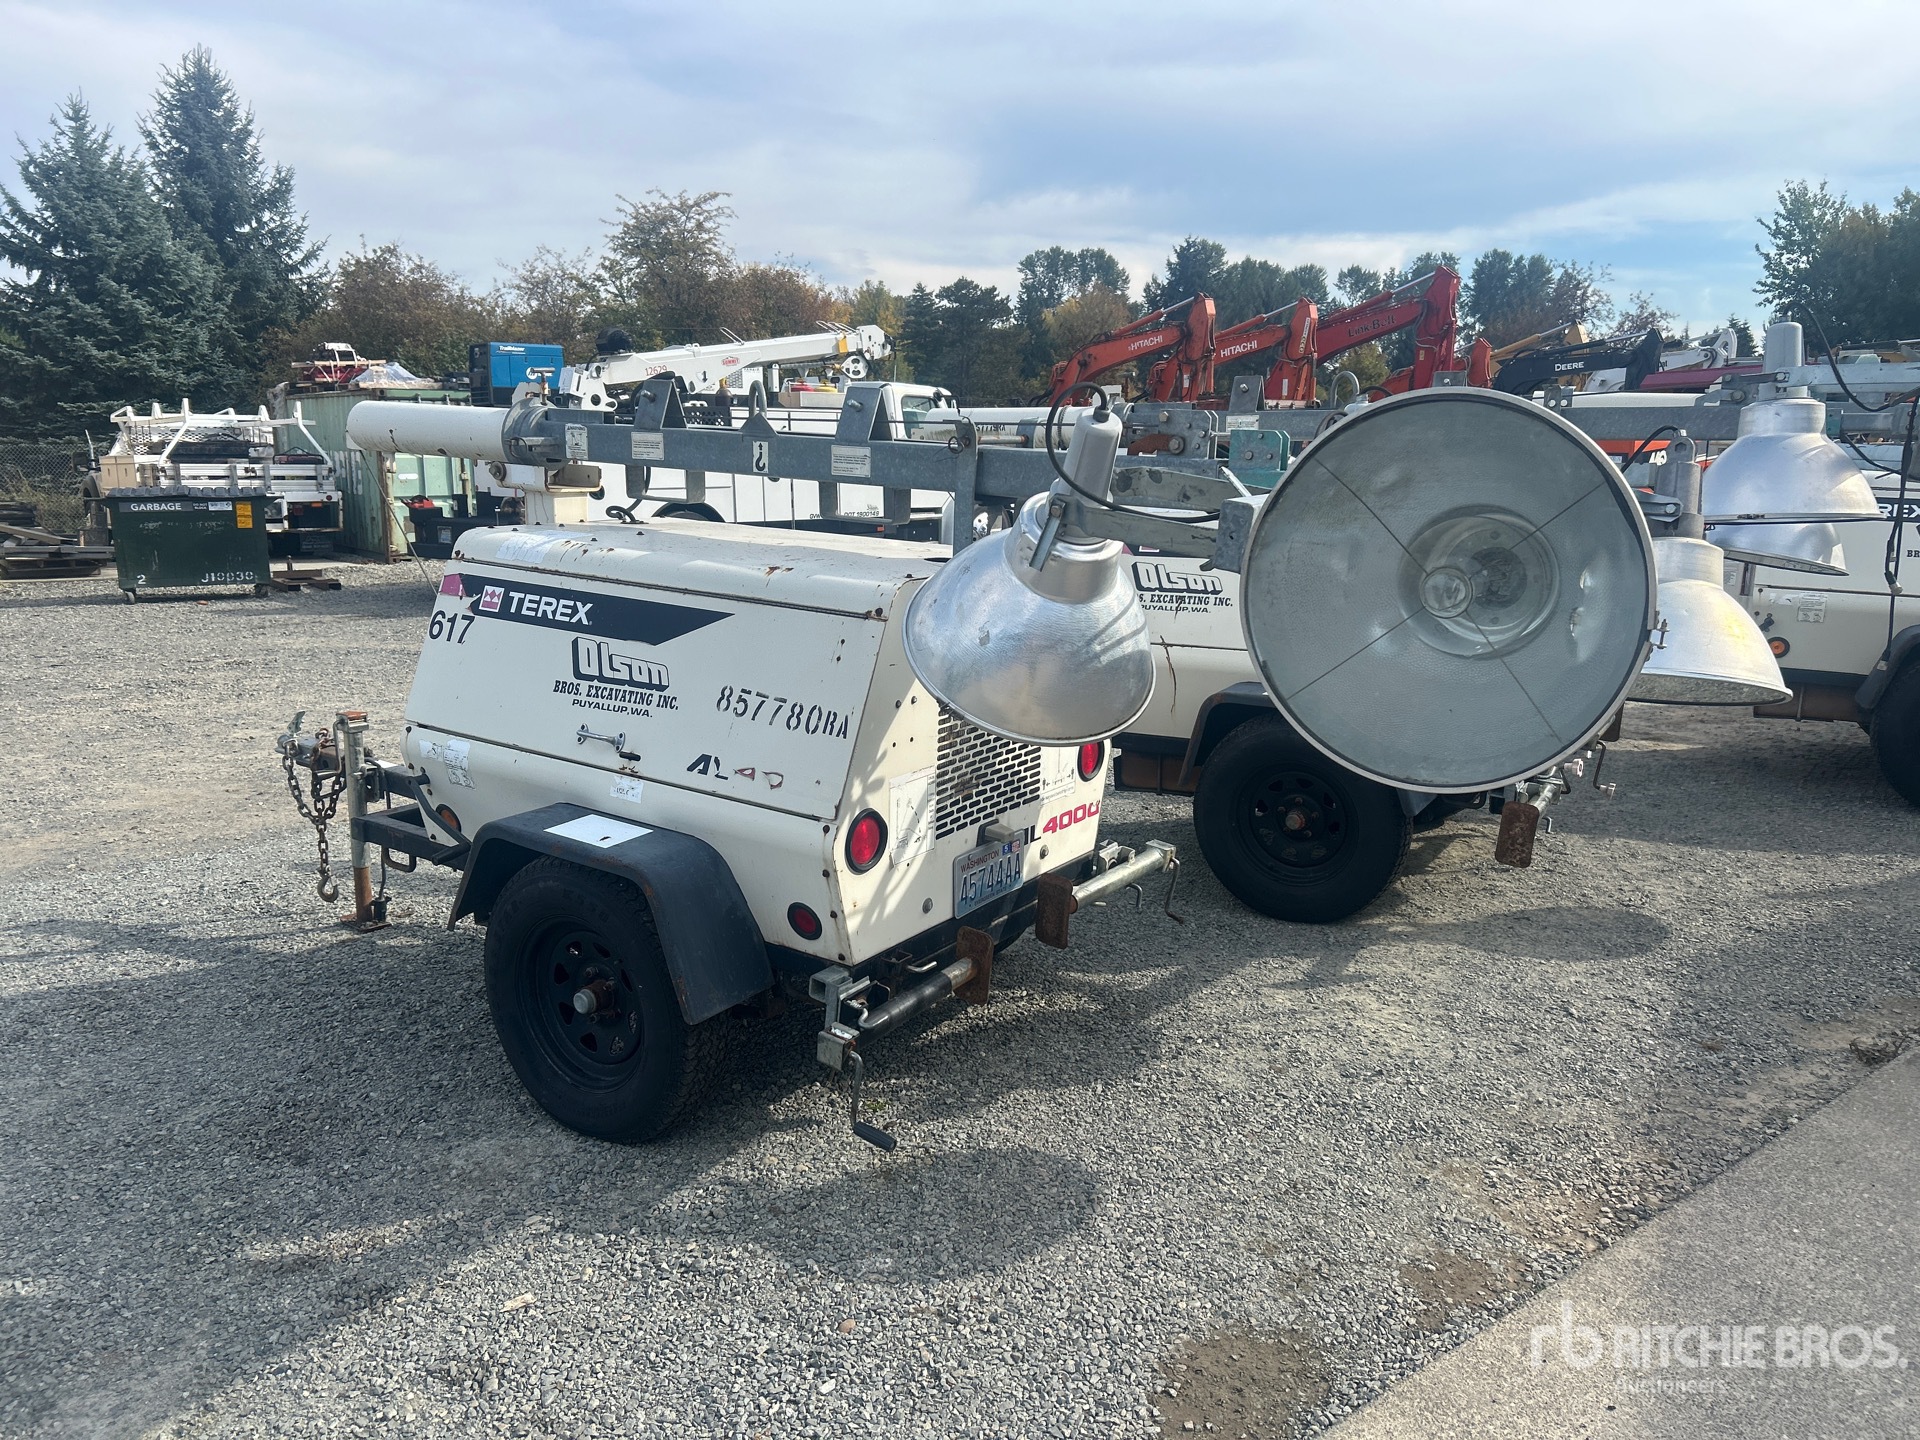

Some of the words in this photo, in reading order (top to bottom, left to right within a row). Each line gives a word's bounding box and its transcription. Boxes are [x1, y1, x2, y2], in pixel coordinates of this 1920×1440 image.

[1348, 315, 1396, 338] Link-Belt
[1130, 334, 1163, 351] HITACHI
[1220, 340, 1258, 358] HITACHI
[1554, 361, 1585, 372] DEERE
[130, 502, 182, 511] GARBAGE
[136, 574, 147, 585] 2
[1131, 561, 1224, 596] Olson
[508, 590, 594, 626] TEREX
[1150, 593, 1210, 606] EXCAVATING
[1213, 596, 1234, 607] INC.
[428, 609, 476, 645] 617
[571, 636, 670, 692] Olson
[553, 679, 582, 697] BROS.
[585, 684, 654, 706] EXCAVATING
[656, 694, 680, 711] INC.
[716, 685, 849, 740] 857780RA
[960, 848, 1000, 874] WASHINGTON
[960, 852, 1021, 905] 45744AA
